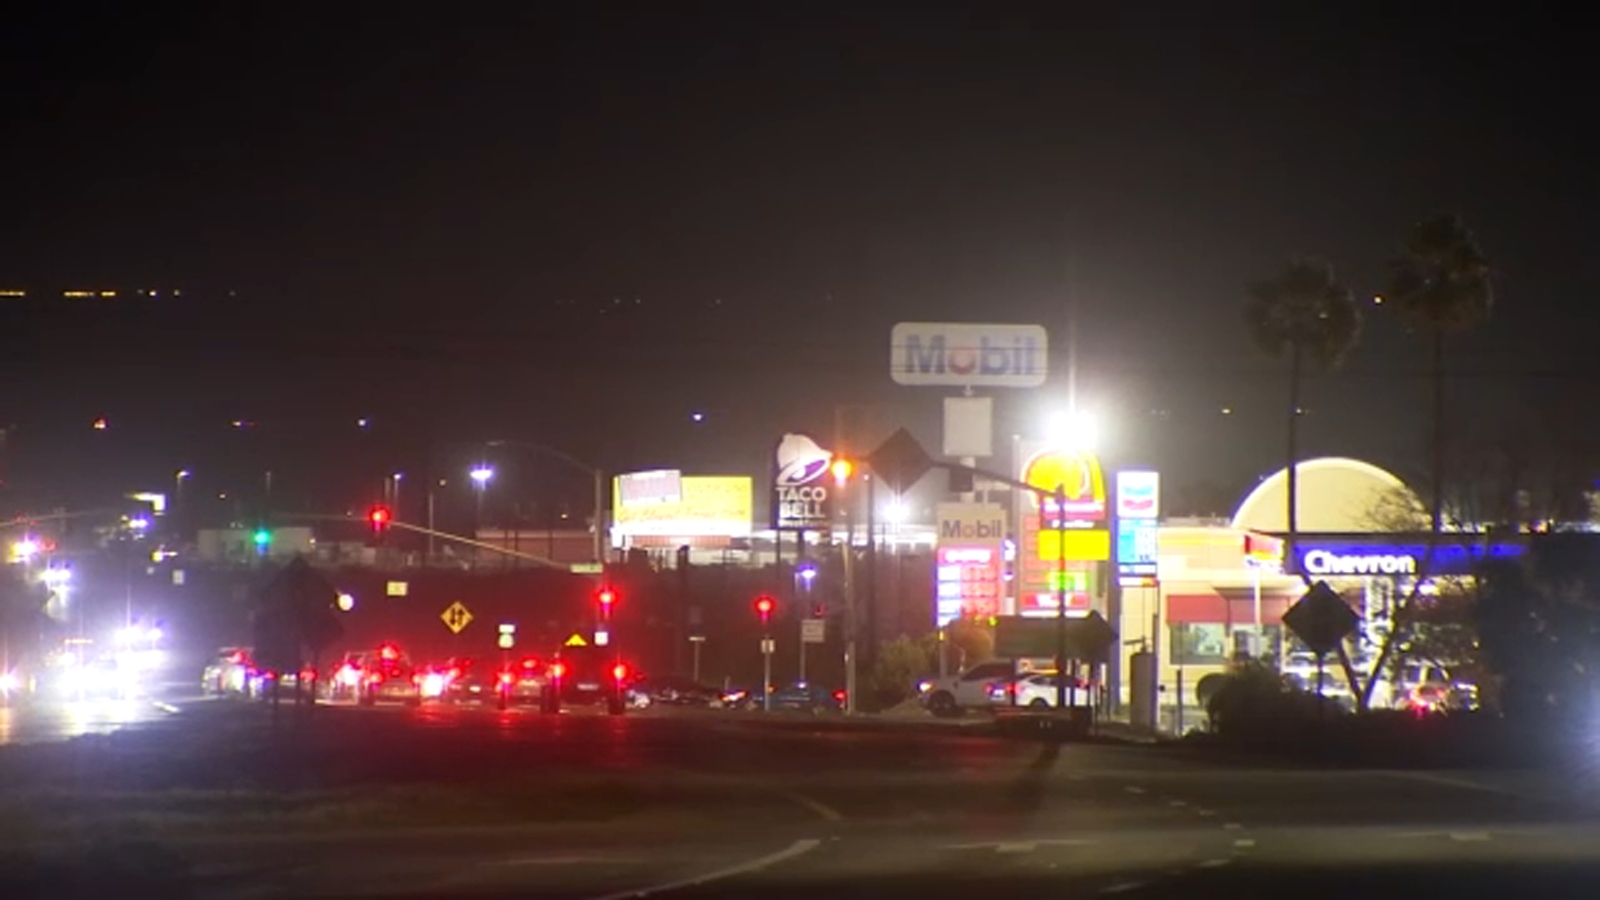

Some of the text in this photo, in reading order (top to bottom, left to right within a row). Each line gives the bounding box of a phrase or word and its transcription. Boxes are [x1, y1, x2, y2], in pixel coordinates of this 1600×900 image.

[904, 334, 1036, 375] Mobil
[775, 486, 826, 501] TACO
[780, 502, 826, 518] BELL
[942, 520, 1001, 538] Mobil
[1304, 550, 1416, 573] Chevron
